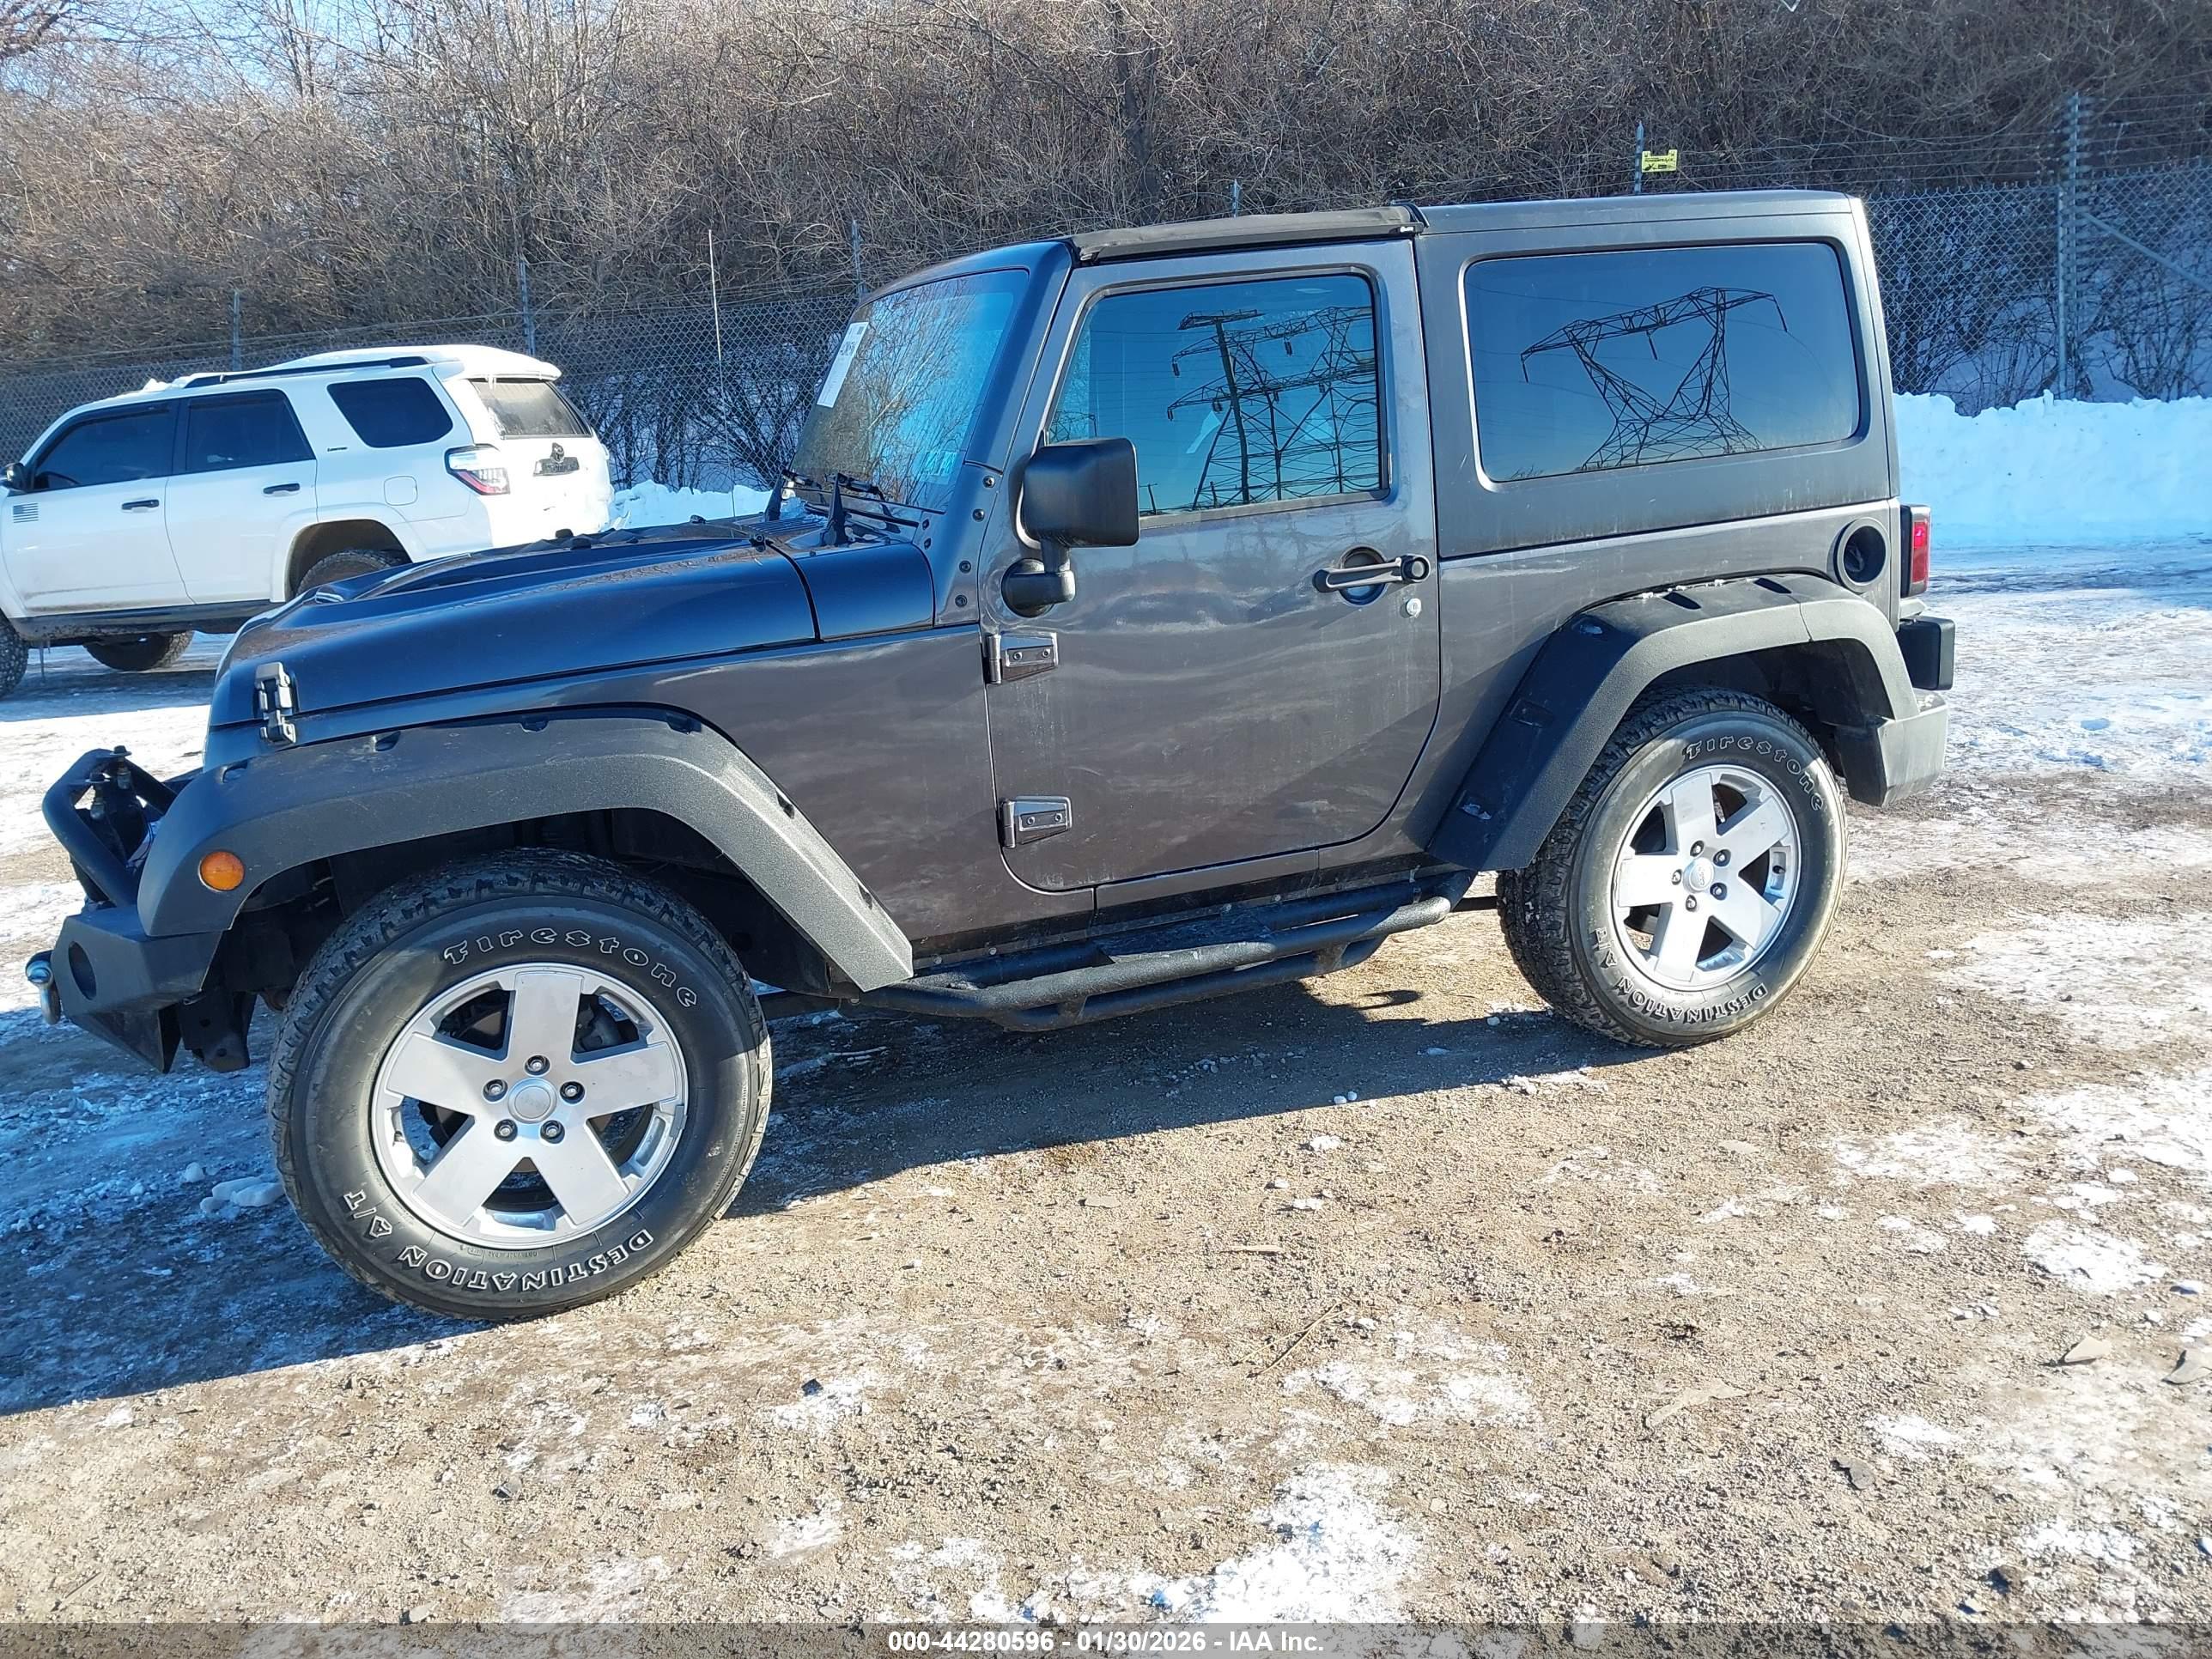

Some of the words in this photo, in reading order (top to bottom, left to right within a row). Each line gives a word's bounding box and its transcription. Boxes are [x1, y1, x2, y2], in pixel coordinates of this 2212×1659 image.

[1682, 735, 1825, 811] Firestone
[443, 927, 697, 1008] Firestone
[1613, 975, 1769, 1025] DESTINATION
[343, 1190, 393, 1239] A/T
[398, 1229, 653, 1292] DESTINATION
